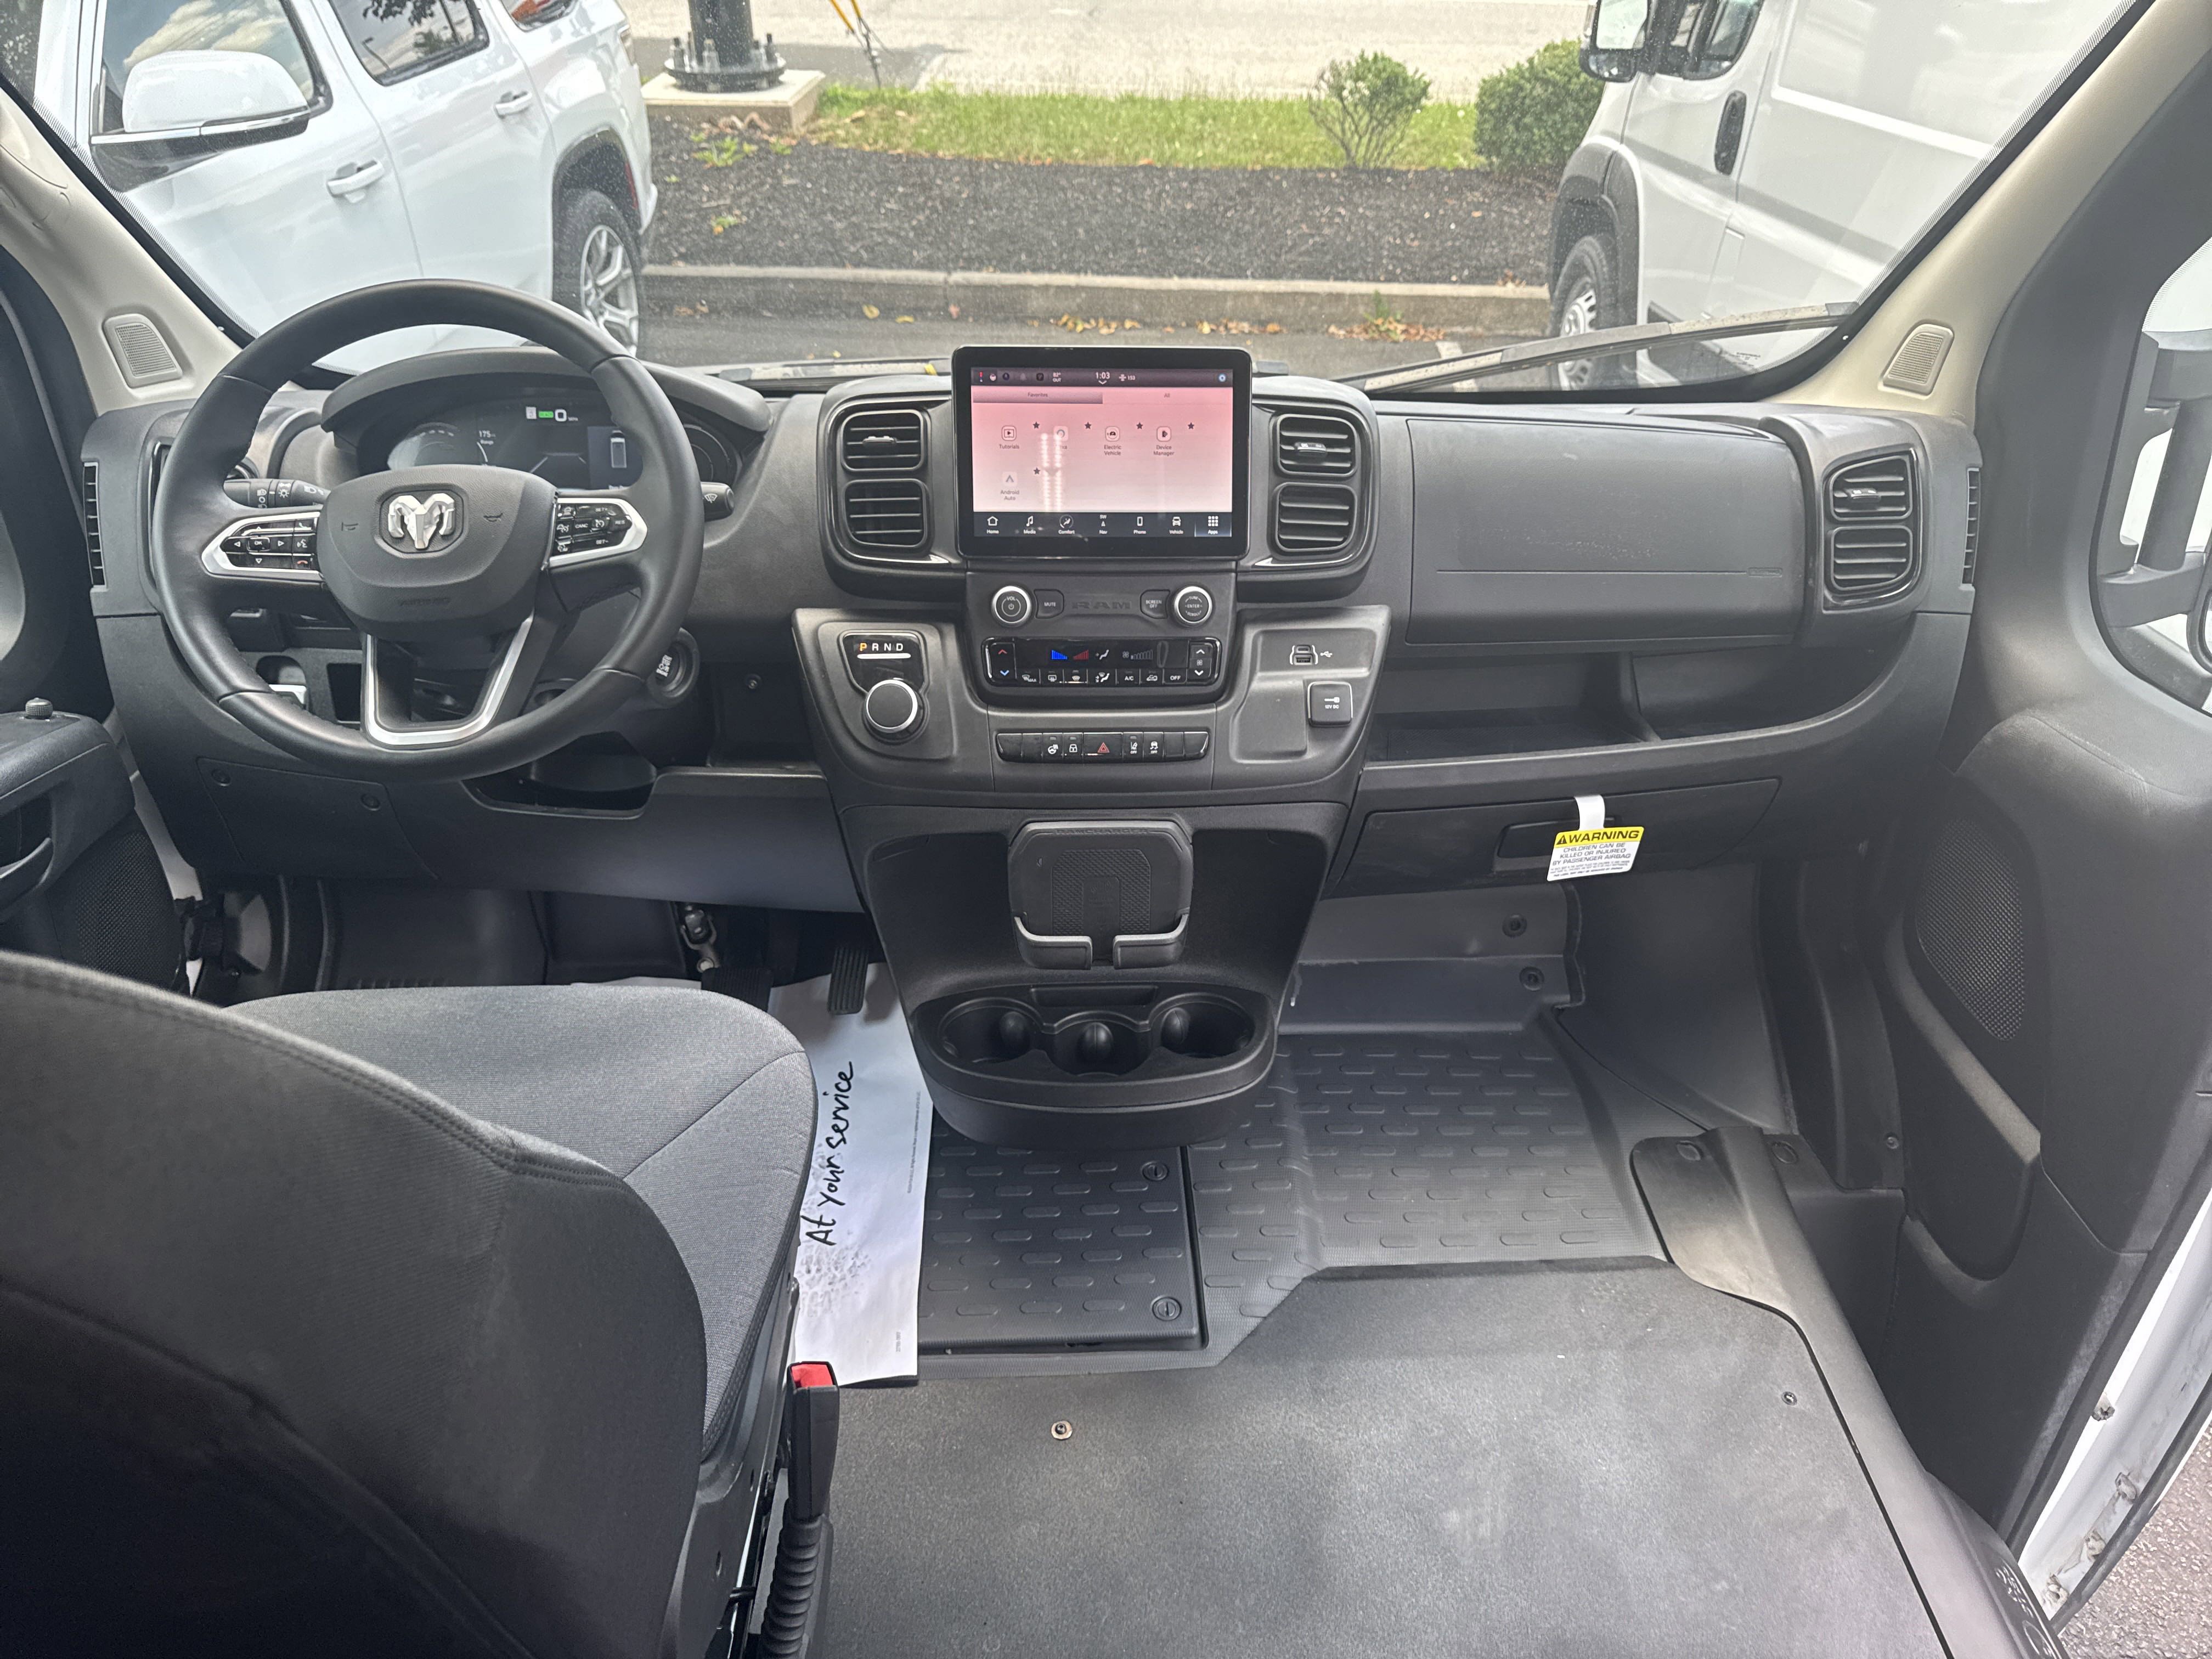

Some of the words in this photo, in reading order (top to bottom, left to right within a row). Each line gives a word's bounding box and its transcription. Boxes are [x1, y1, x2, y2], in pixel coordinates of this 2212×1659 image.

[1072, 601, 1131, 610] RAM
[860, 643, 867, 651] P
[1569, 830, 1639, 843] WARNING
[1564, 844, 1597, 853] CHILDREN
[1563, 855, 1602, 864] PASSENGER
[800, 1214, 837, 1246] At
[822, 1061, 854, 1149] service
